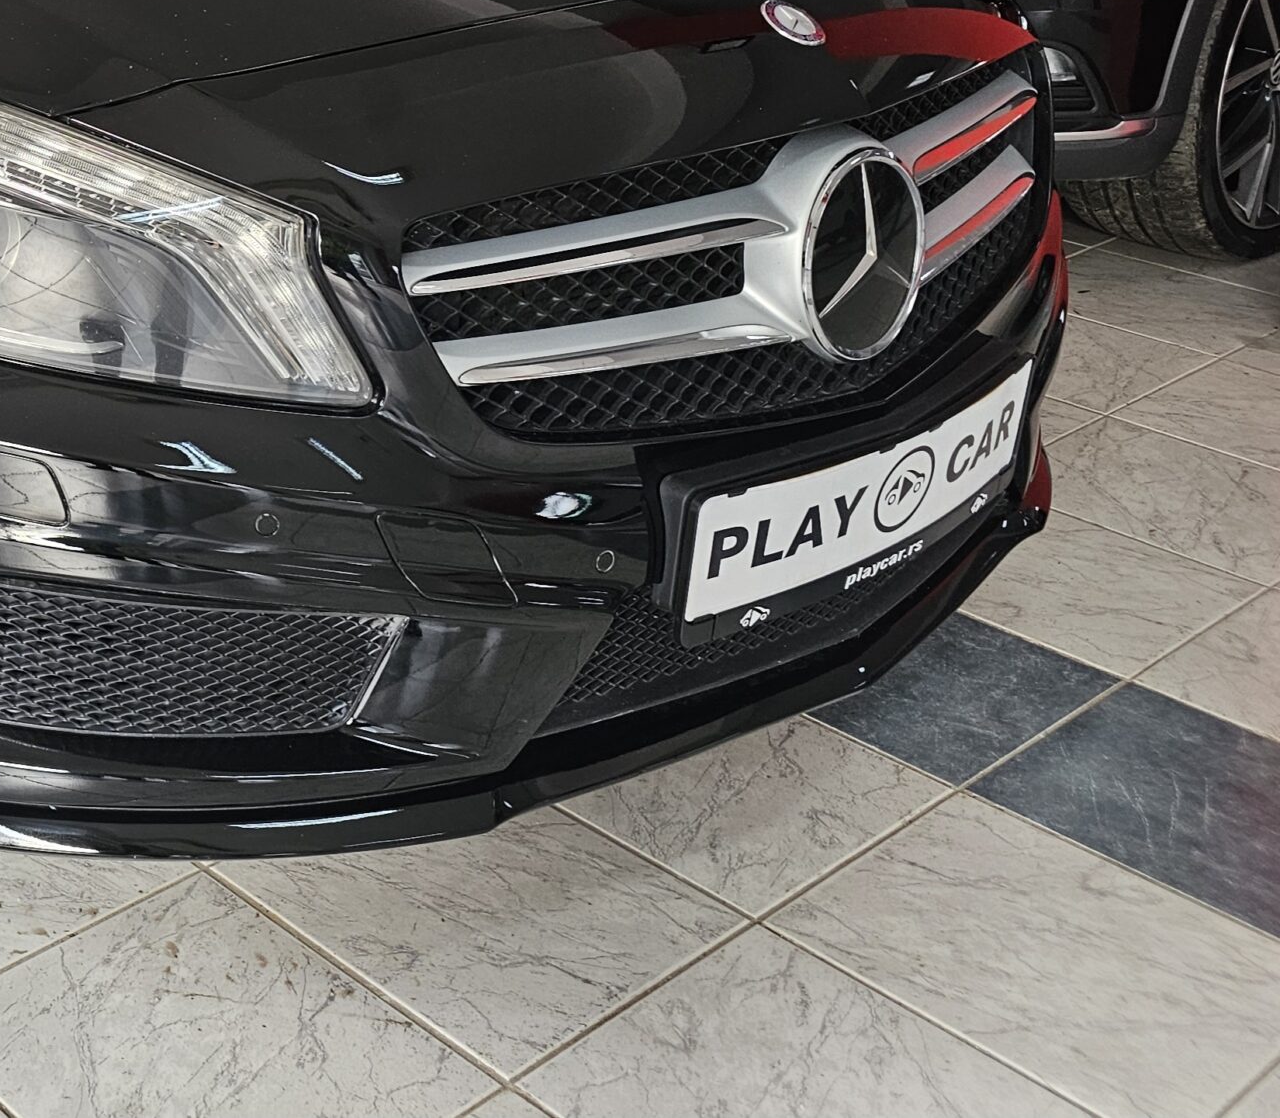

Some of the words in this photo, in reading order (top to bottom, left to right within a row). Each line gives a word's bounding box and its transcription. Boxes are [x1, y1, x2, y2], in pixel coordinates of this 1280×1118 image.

[707, 486, 869, 580] PLAY
[946, 400, 1016, 483] CAR
[844, 537, 924, 590] playcar.rs
